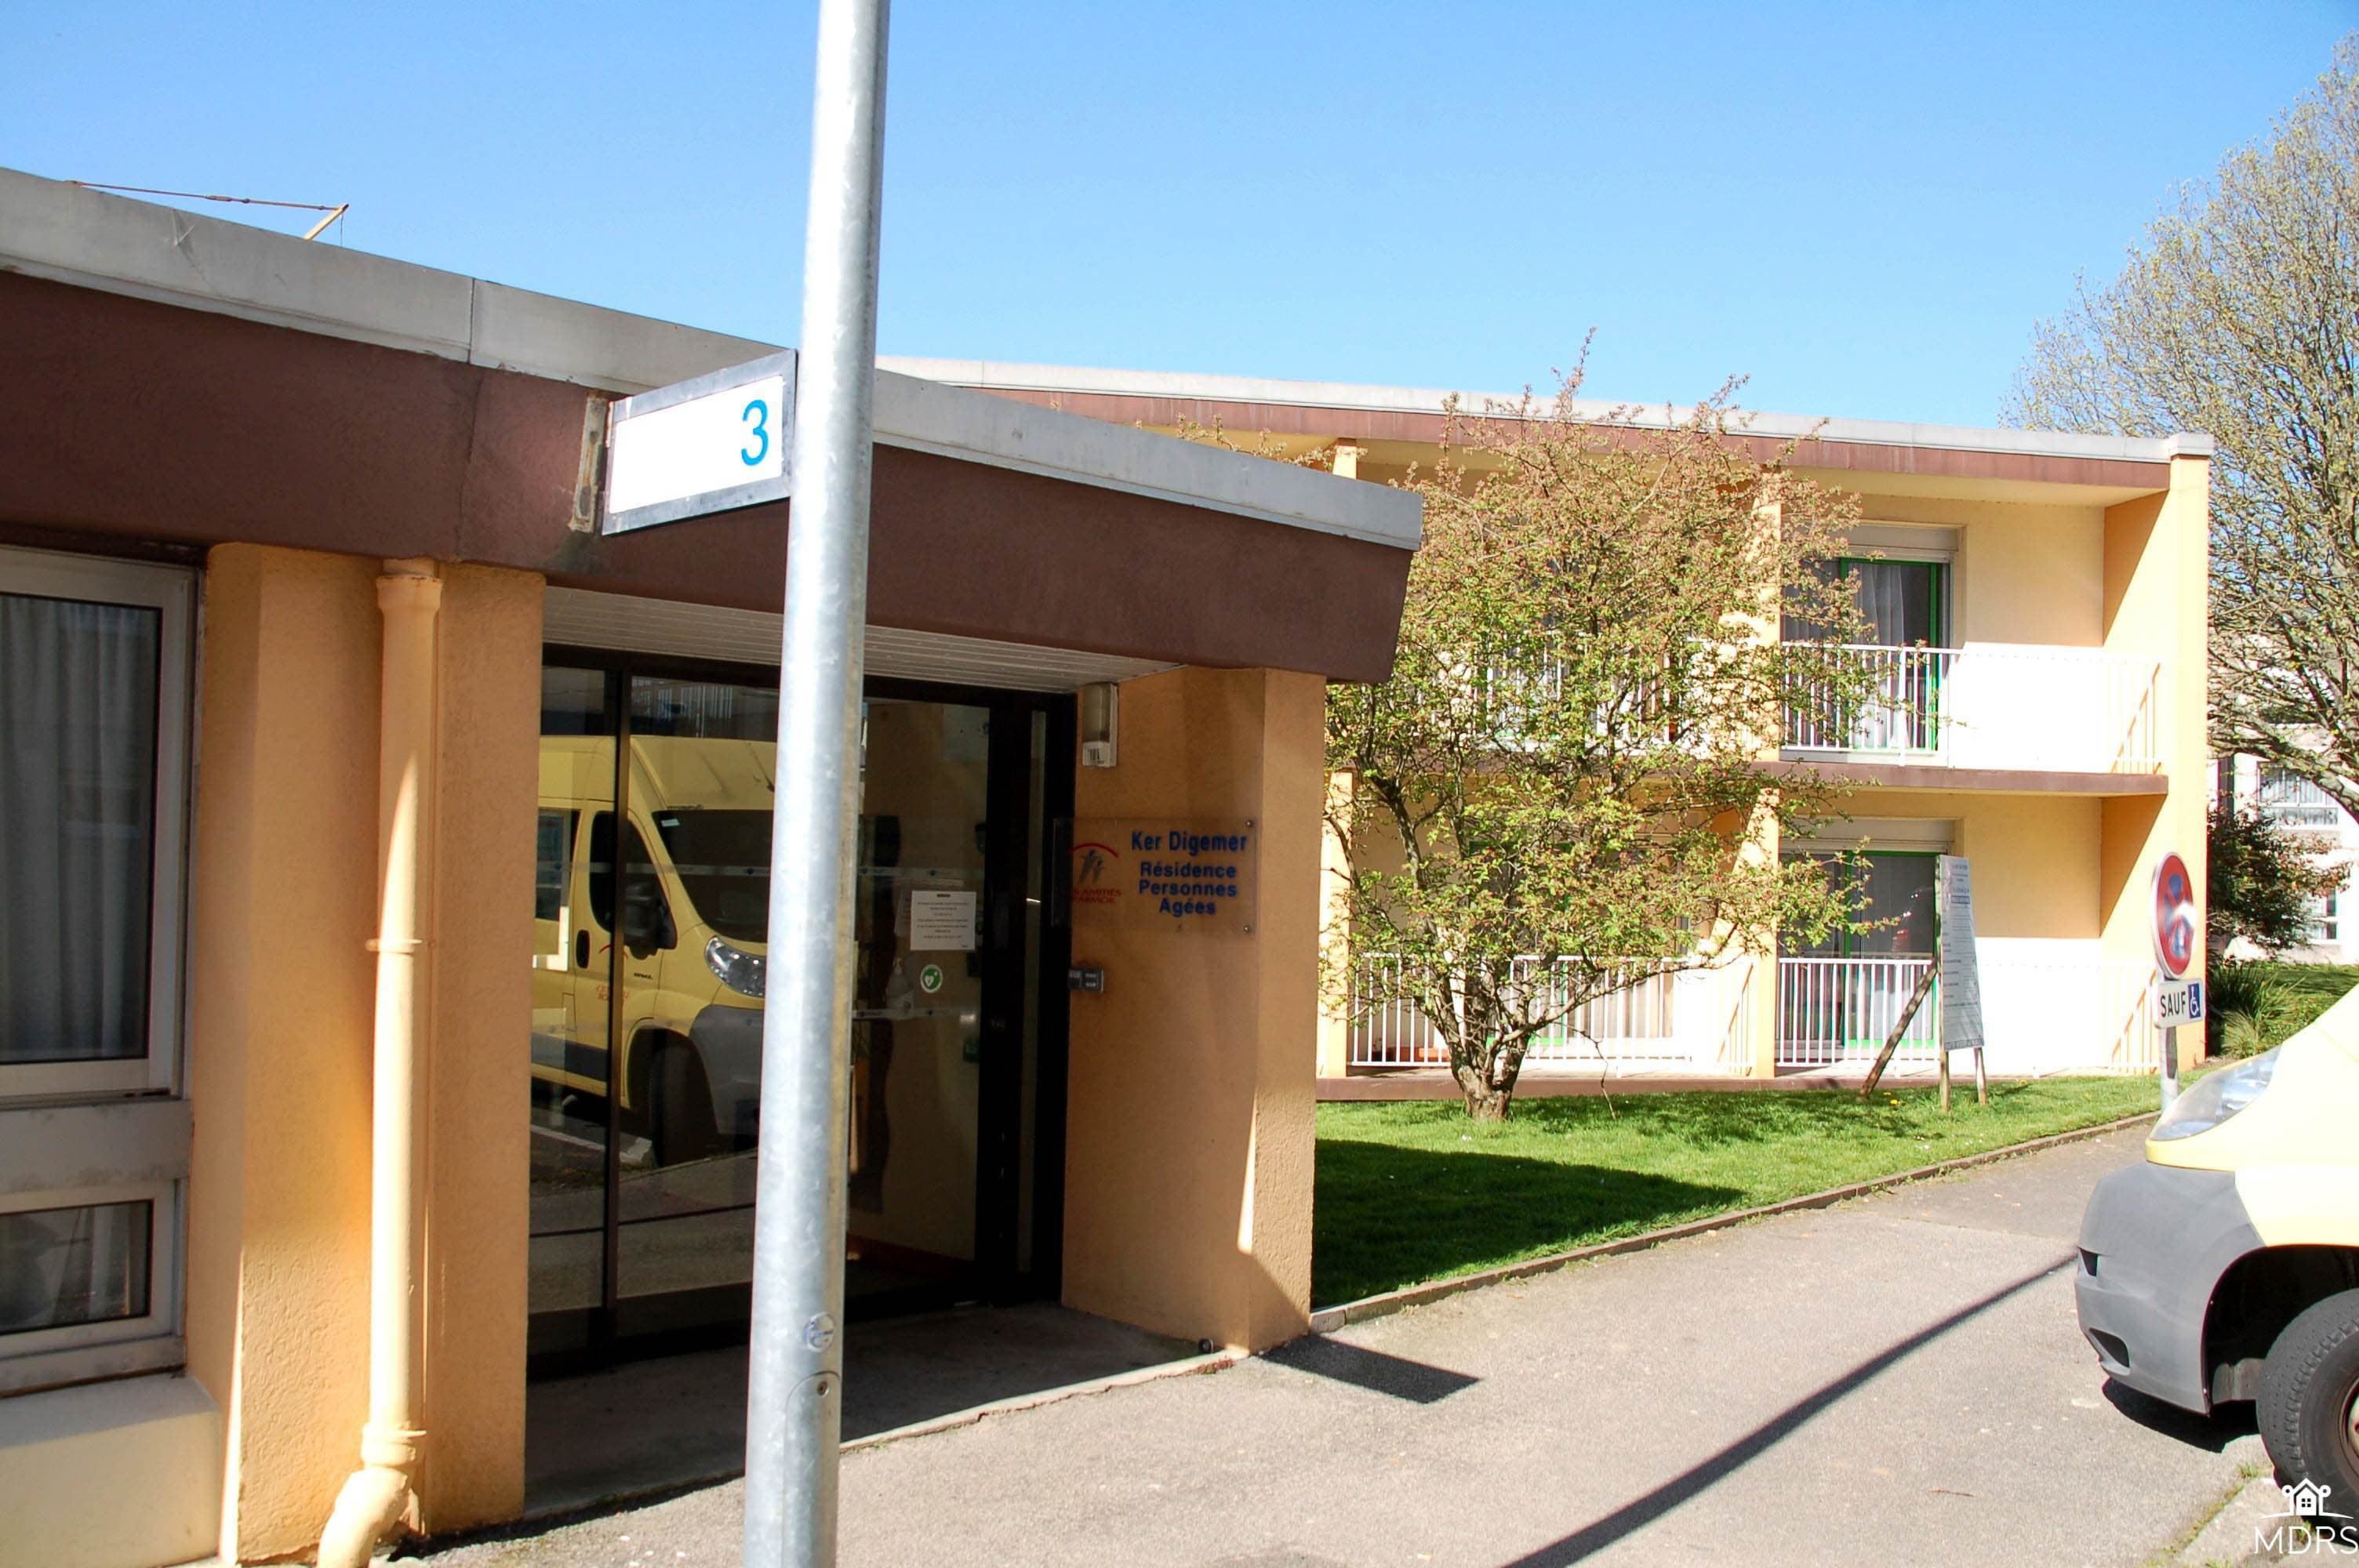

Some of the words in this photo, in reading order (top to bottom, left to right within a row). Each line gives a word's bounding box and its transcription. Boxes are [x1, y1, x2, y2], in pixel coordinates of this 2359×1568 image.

[740, 399, 769, 466] 3
[1132, 831, 1161, 851] Ker
[1169, 831, 1248, 856] Digemer
[1140, 862, 1237, 878] Résidence
[1139, 880, 1237, 897] Personnes
[1159, 898, 1216, 916] Agées
[2160, 991, 2186, 1018] SAUF
